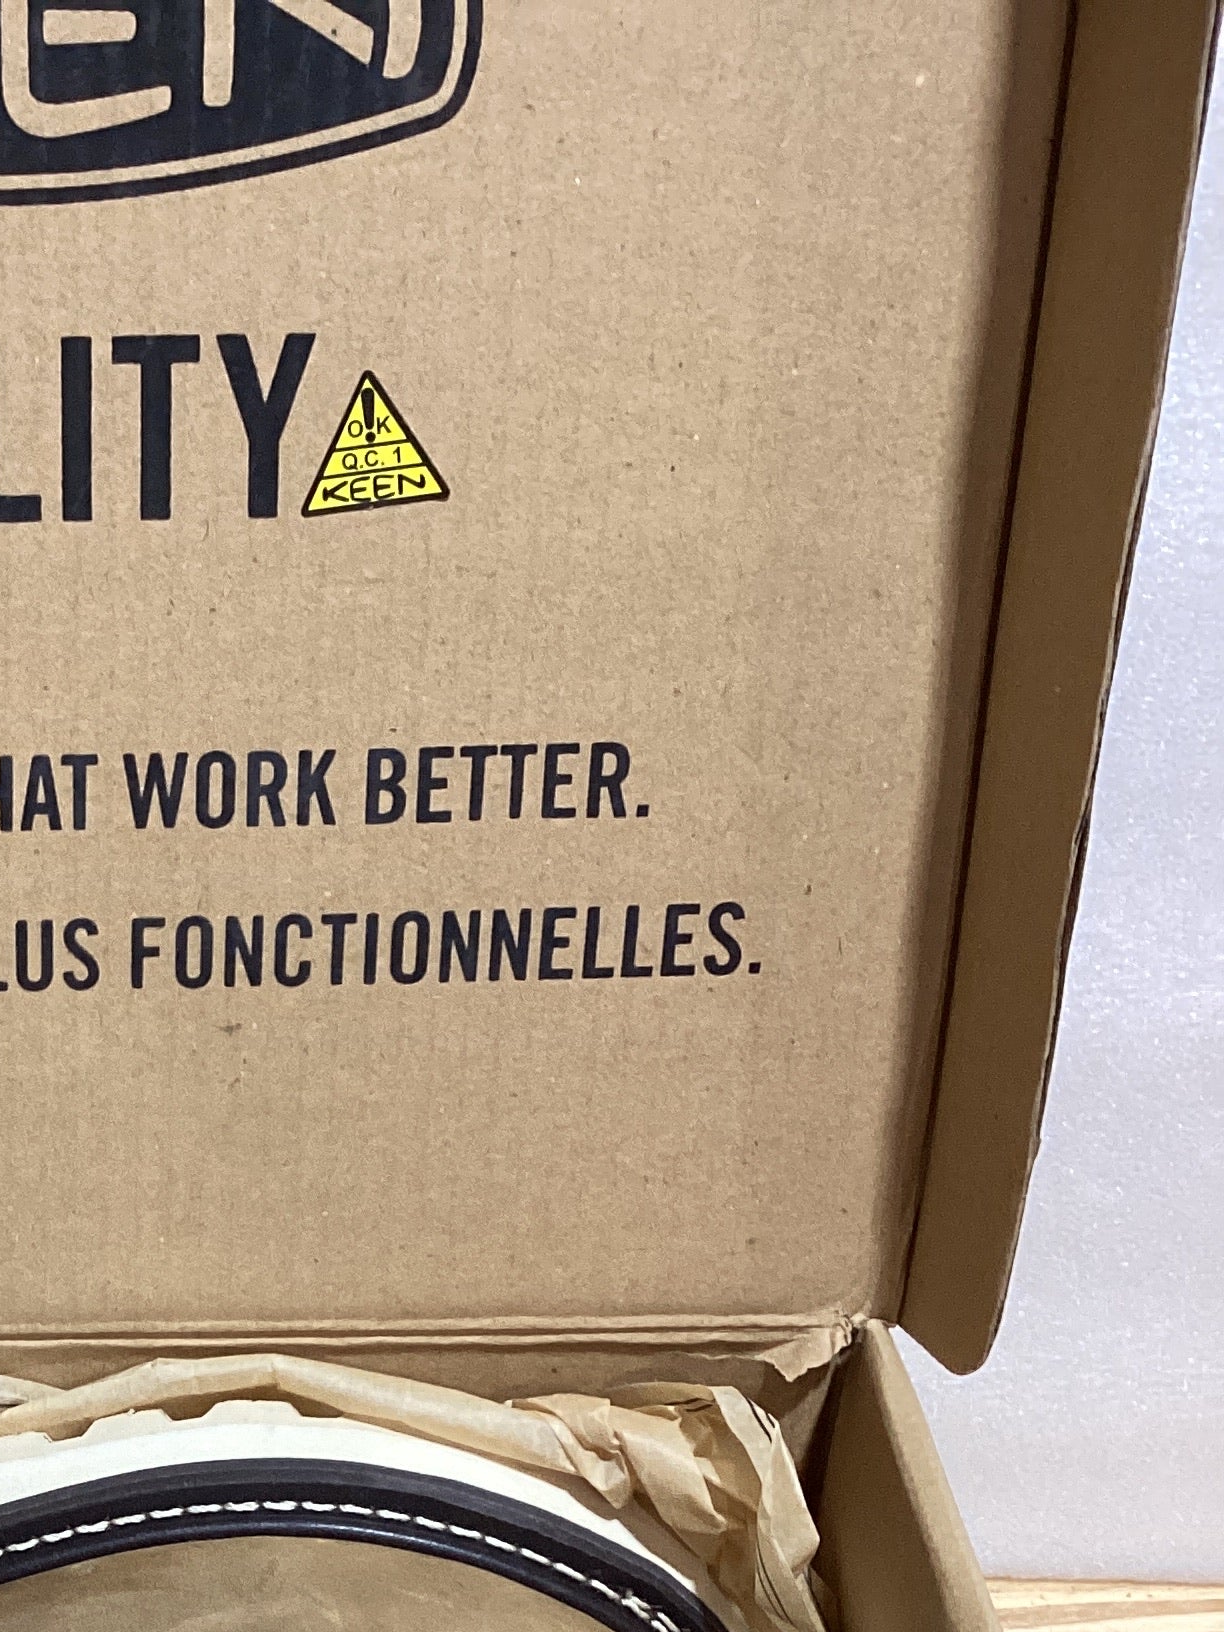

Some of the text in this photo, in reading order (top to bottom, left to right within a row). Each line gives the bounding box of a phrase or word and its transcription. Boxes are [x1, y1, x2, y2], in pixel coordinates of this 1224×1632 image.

[322, 473, 427, 503] KEEN
[341, 446, 402, 471] Q.C. 1
[122, 749, 337, 830] WORK
[364, 741, 650, 825] BETTER.
[130, 901, 762, 990] FONCTIONNELLES.
